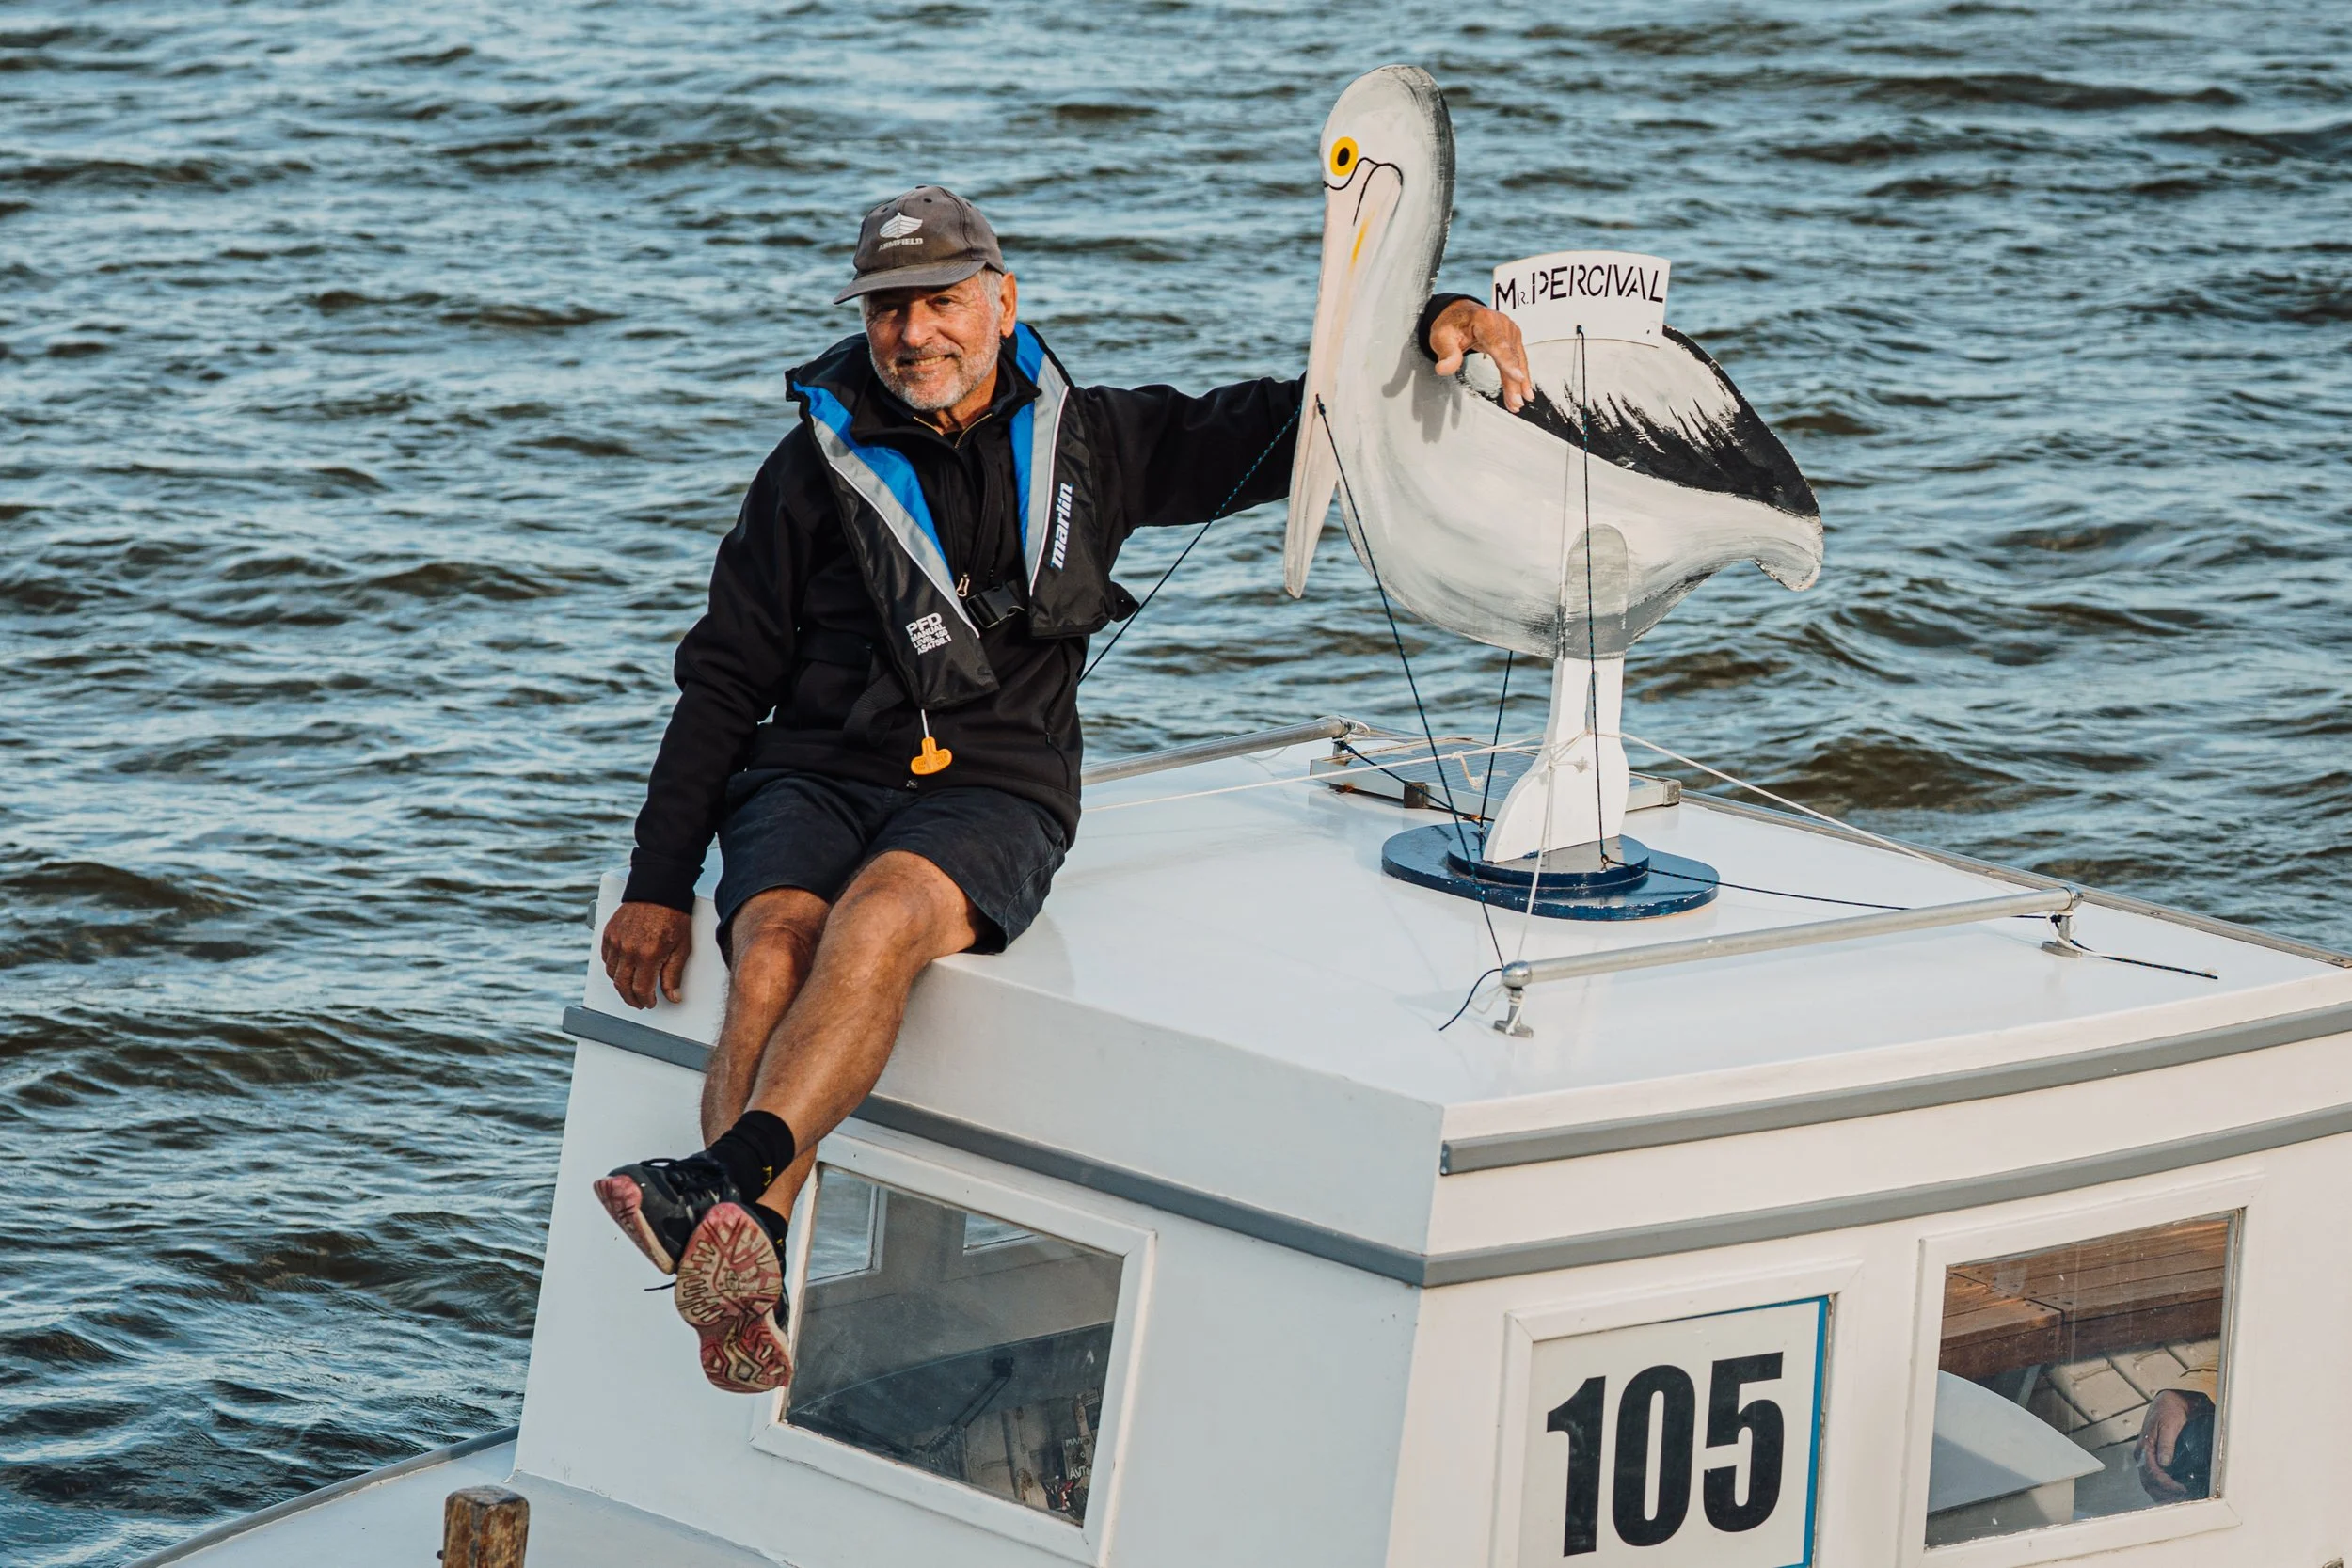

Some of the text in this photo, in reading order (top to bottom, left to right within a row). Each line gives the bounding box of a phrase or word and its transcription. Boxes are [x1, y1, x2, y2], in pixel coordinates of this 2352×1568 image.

[878, 237, 924, 252] ARMFIELD
[1532, 264, 1664, 305] PERCIVAL
[1051, 483, 1073, 570] marlin
[905, 612, 943, 636] PFD
[910, 625, 946, 642] MANUAL
[913, 629, 948, 649] LEVEL 150
[1547, 1352, 1785, 1557] 105
